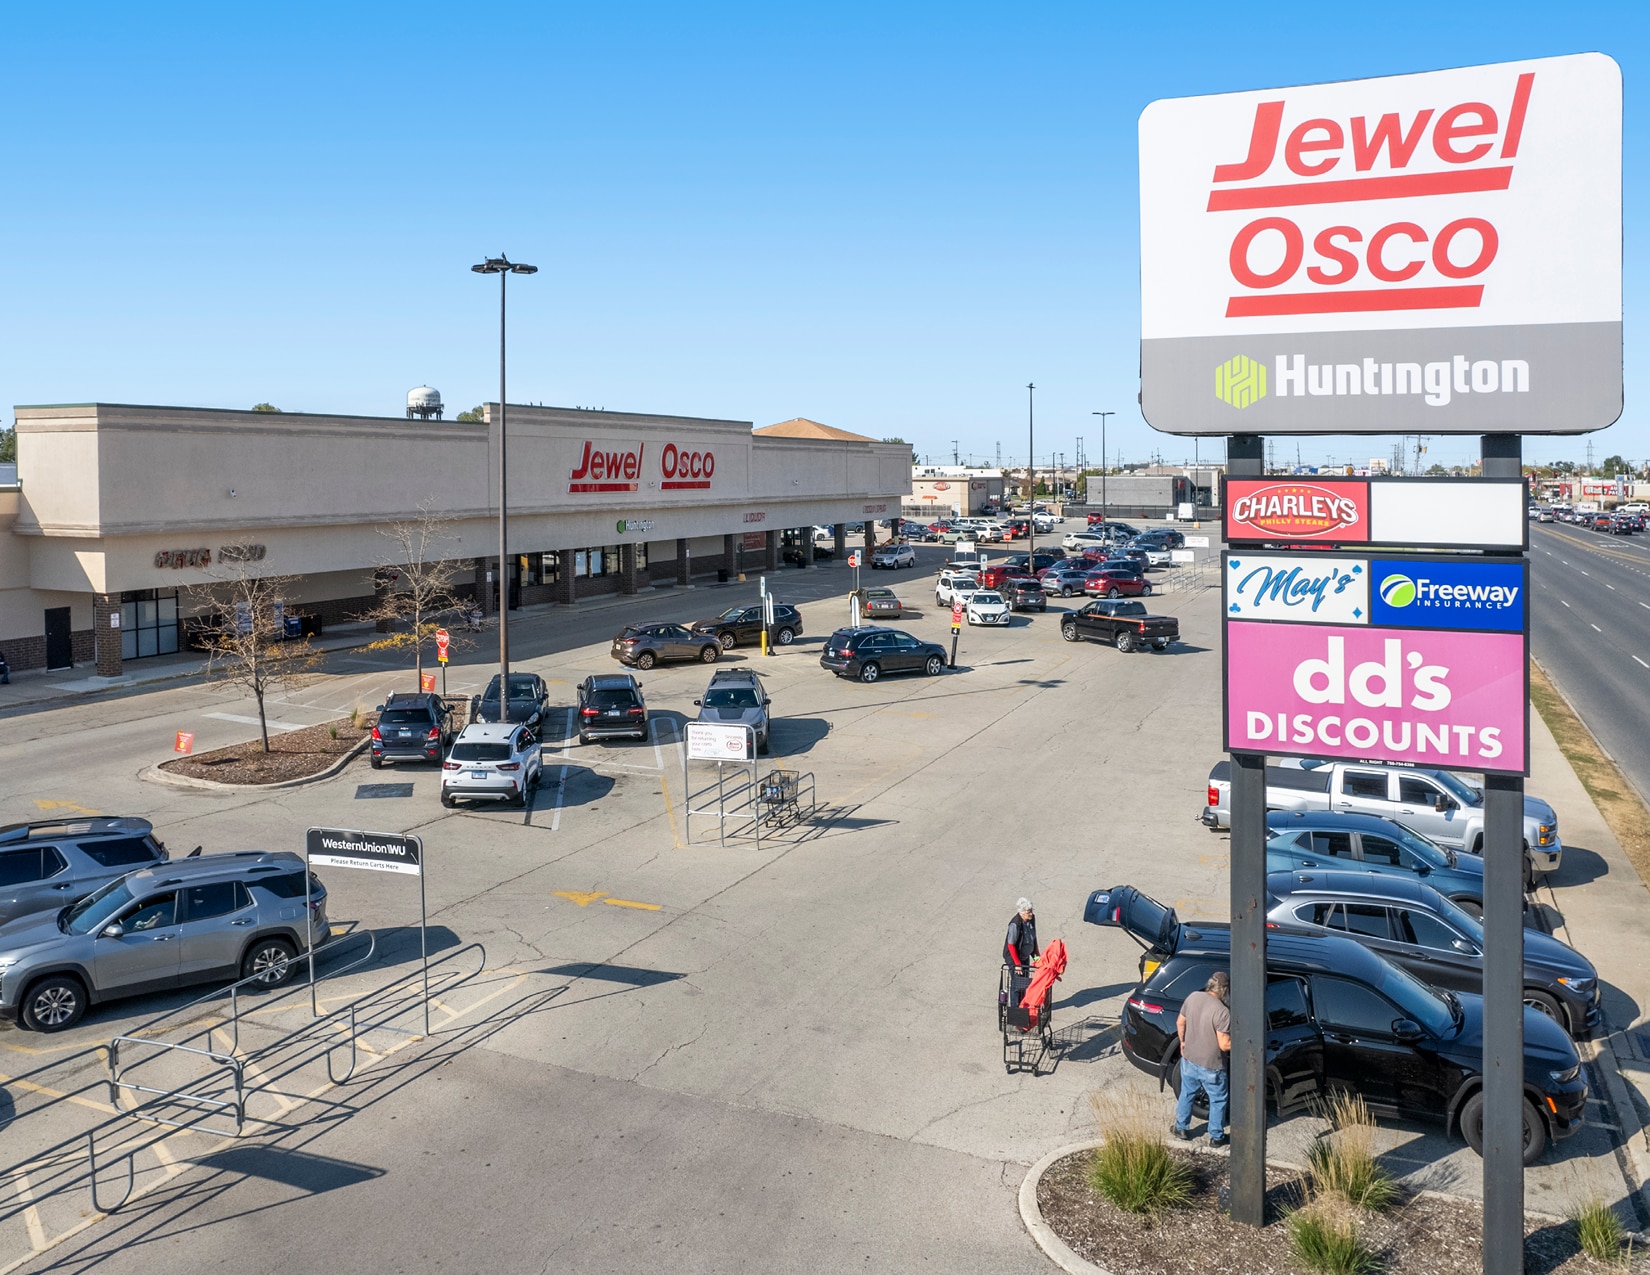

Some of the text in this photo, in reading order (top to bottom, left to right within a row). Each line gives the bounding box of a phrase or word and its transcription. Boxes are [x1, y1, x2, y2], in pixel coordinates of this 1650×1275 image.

[1212, 72, 1536, 183] Jewel
[1229, 216, 1499, 289] Osco
[1275, 353, 1530, 407] Huntington
[569, 440, 715, 480] Jewel Osco
[625, 519, 655, 532] Huntington
[1233, 494, 1358, 524] CHARLEYS
[1260, 518, 1330, 527] PHILLY STEAKS
[1236, 565, 1356, 614] May's
[1416, 578, 1519, 608] Freeway
[1416, 600, 1503, 610] INSURANCE
[1292, 635, 1452, 712] dd's
[1246, 710, 1503, 759] DISCOUNTS
